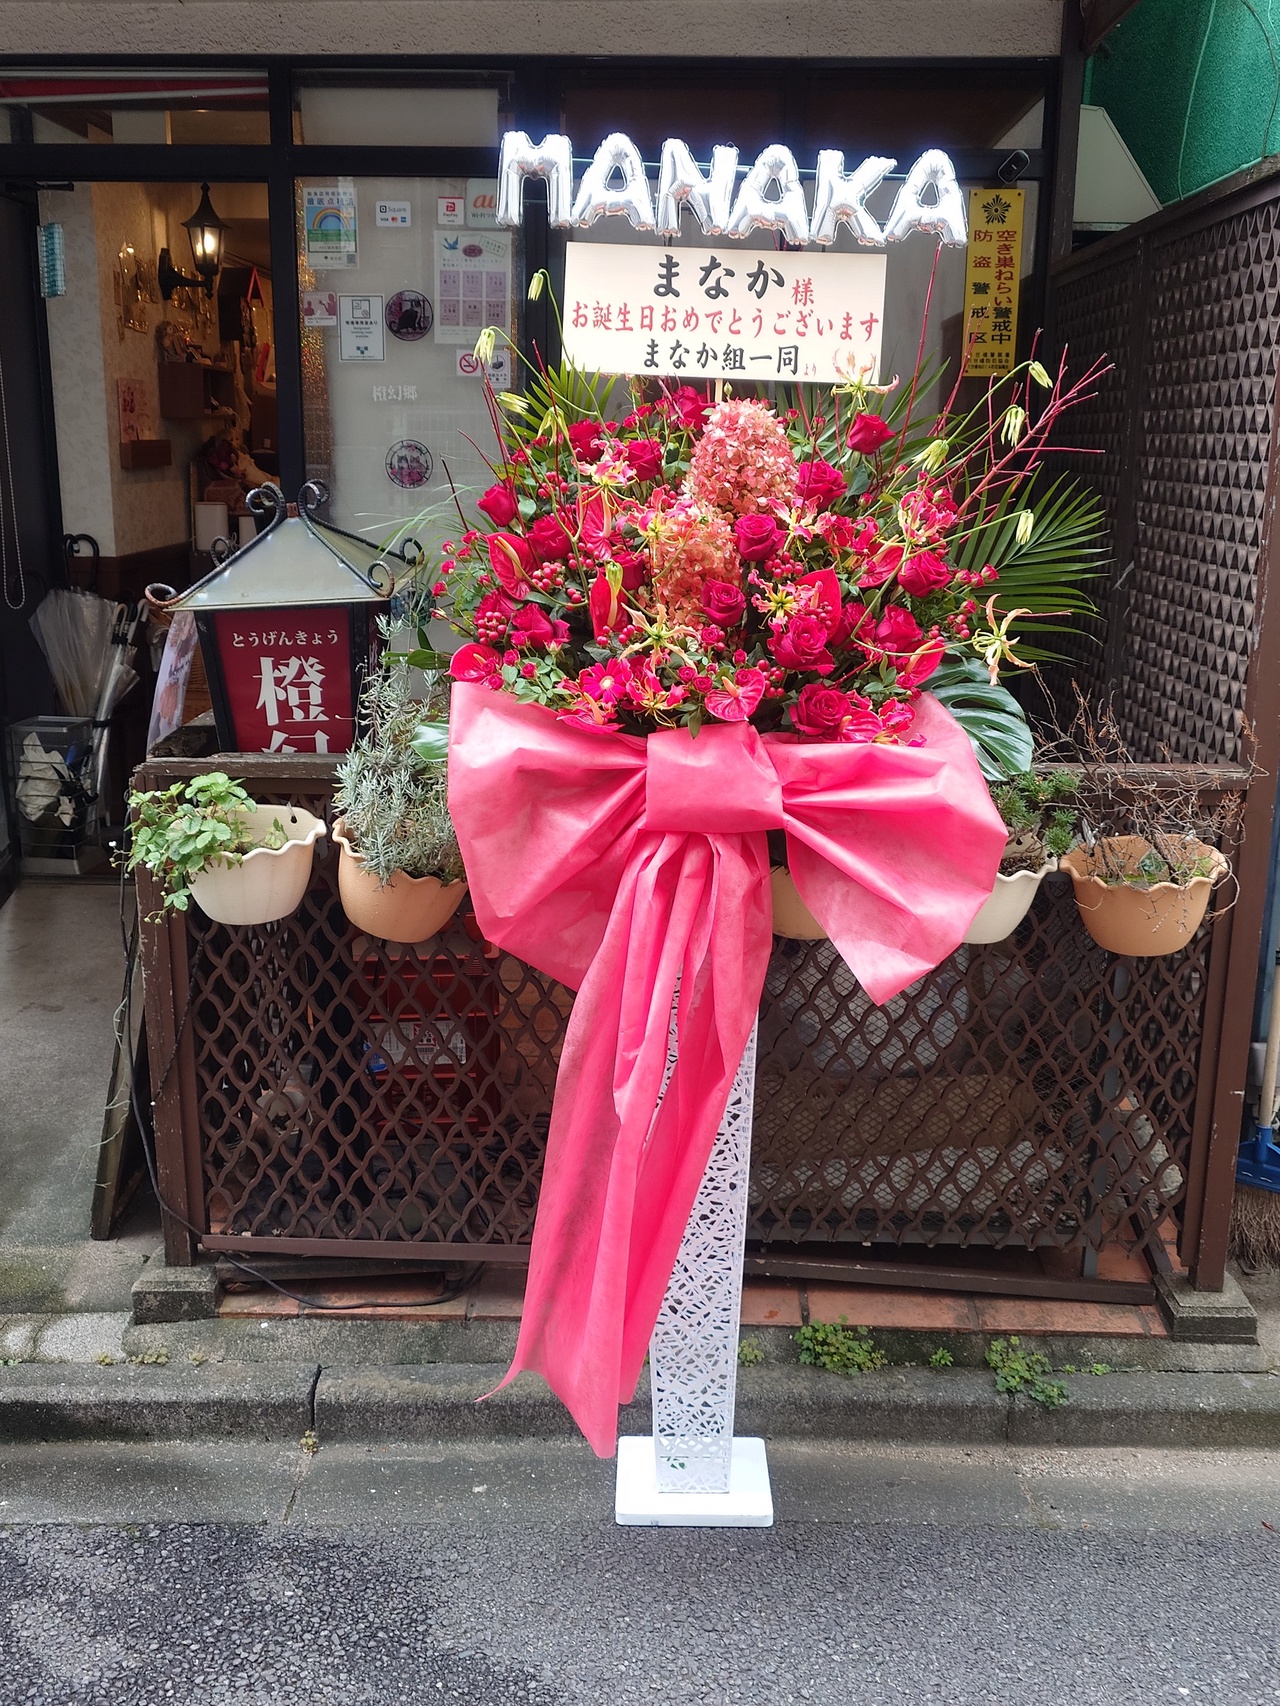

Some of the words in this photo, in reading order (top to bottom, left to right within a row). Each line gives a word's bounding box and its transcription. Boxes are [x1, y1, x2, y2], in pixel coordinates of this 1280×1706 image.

[388, 205, 407, 213] Square
[497, 131, 969, 247] MANAKA
[992, 230, 1017, 345] 空き巣ねらい警戒中
[571, 300, 879, 342] お誕生日おめでとうございます
[232, 629, 339, 648] とうげんきょう
